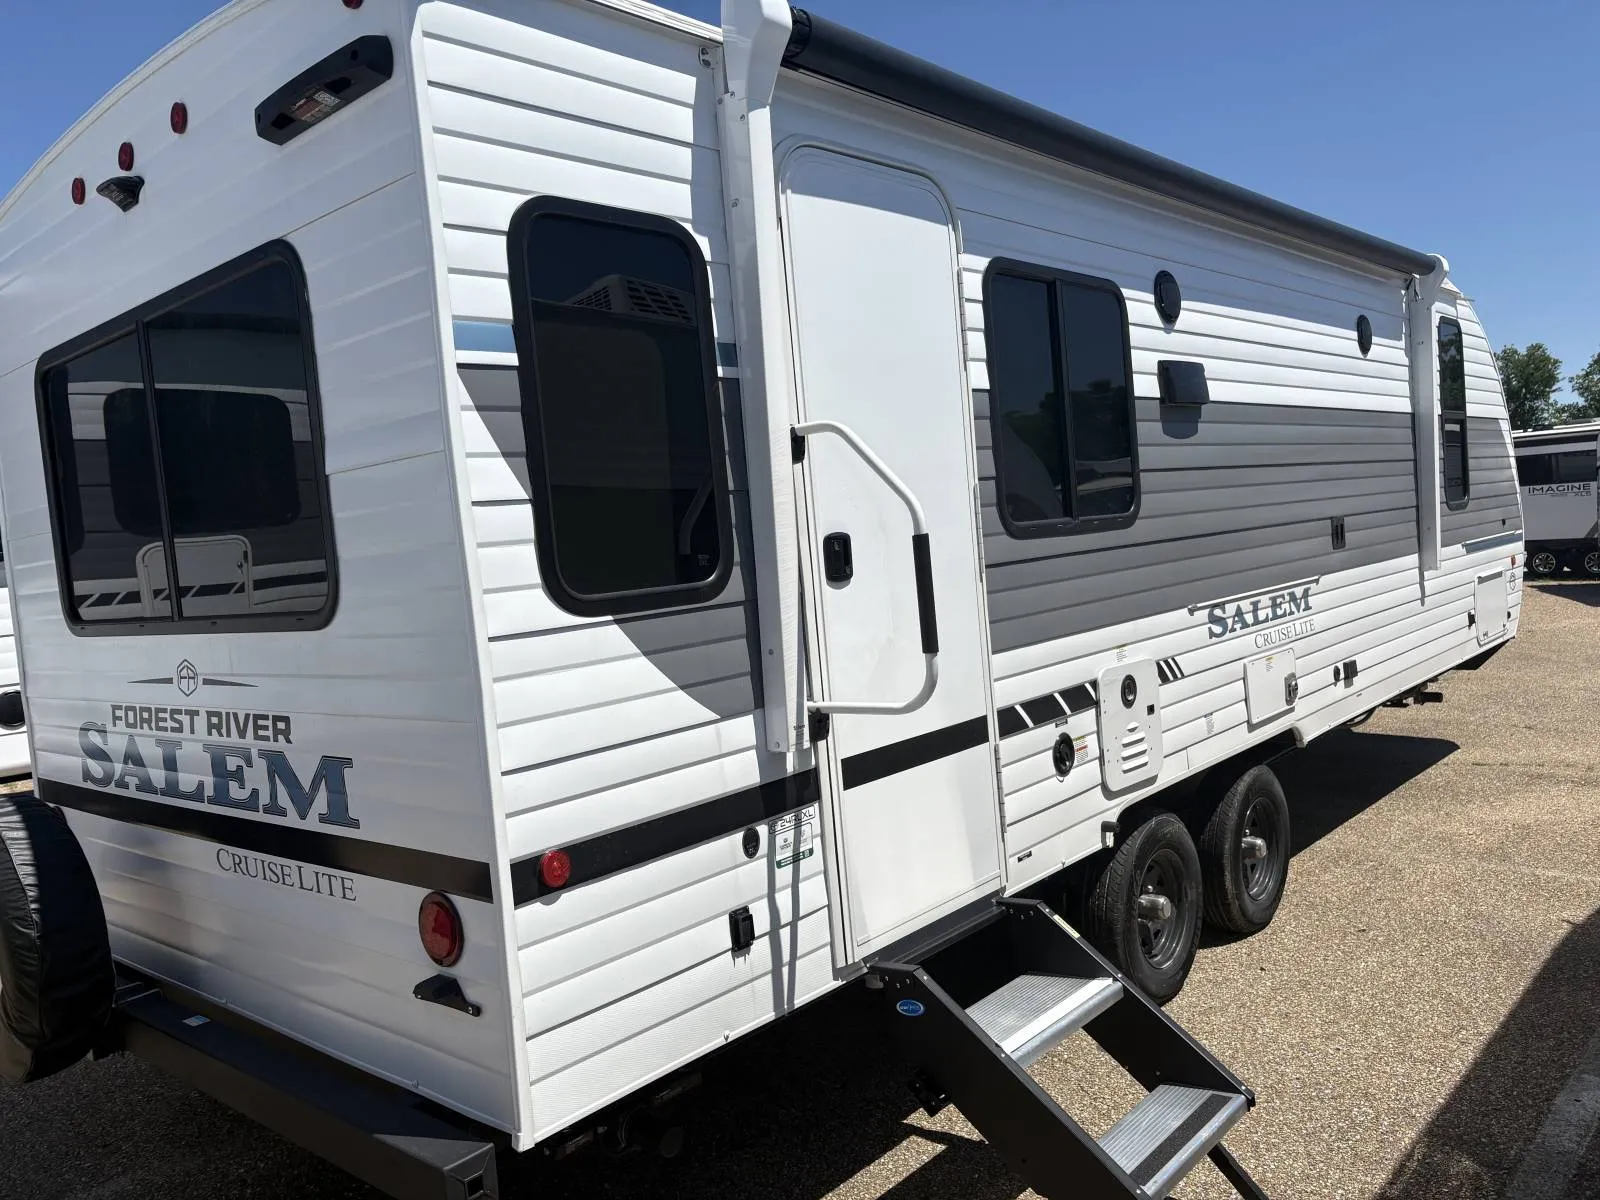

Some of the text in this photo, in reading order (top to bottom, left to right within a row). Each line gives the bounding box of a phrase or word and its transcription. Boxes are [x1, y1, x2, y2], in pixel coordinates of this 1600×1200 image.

[1528, 483, 1591, 493] IMAGINE
[1208, 587, 1312, 639] SALEM
[111, 704, 293, 744] FOREST RIVER
[78, 721, 361, 829] SALEM
